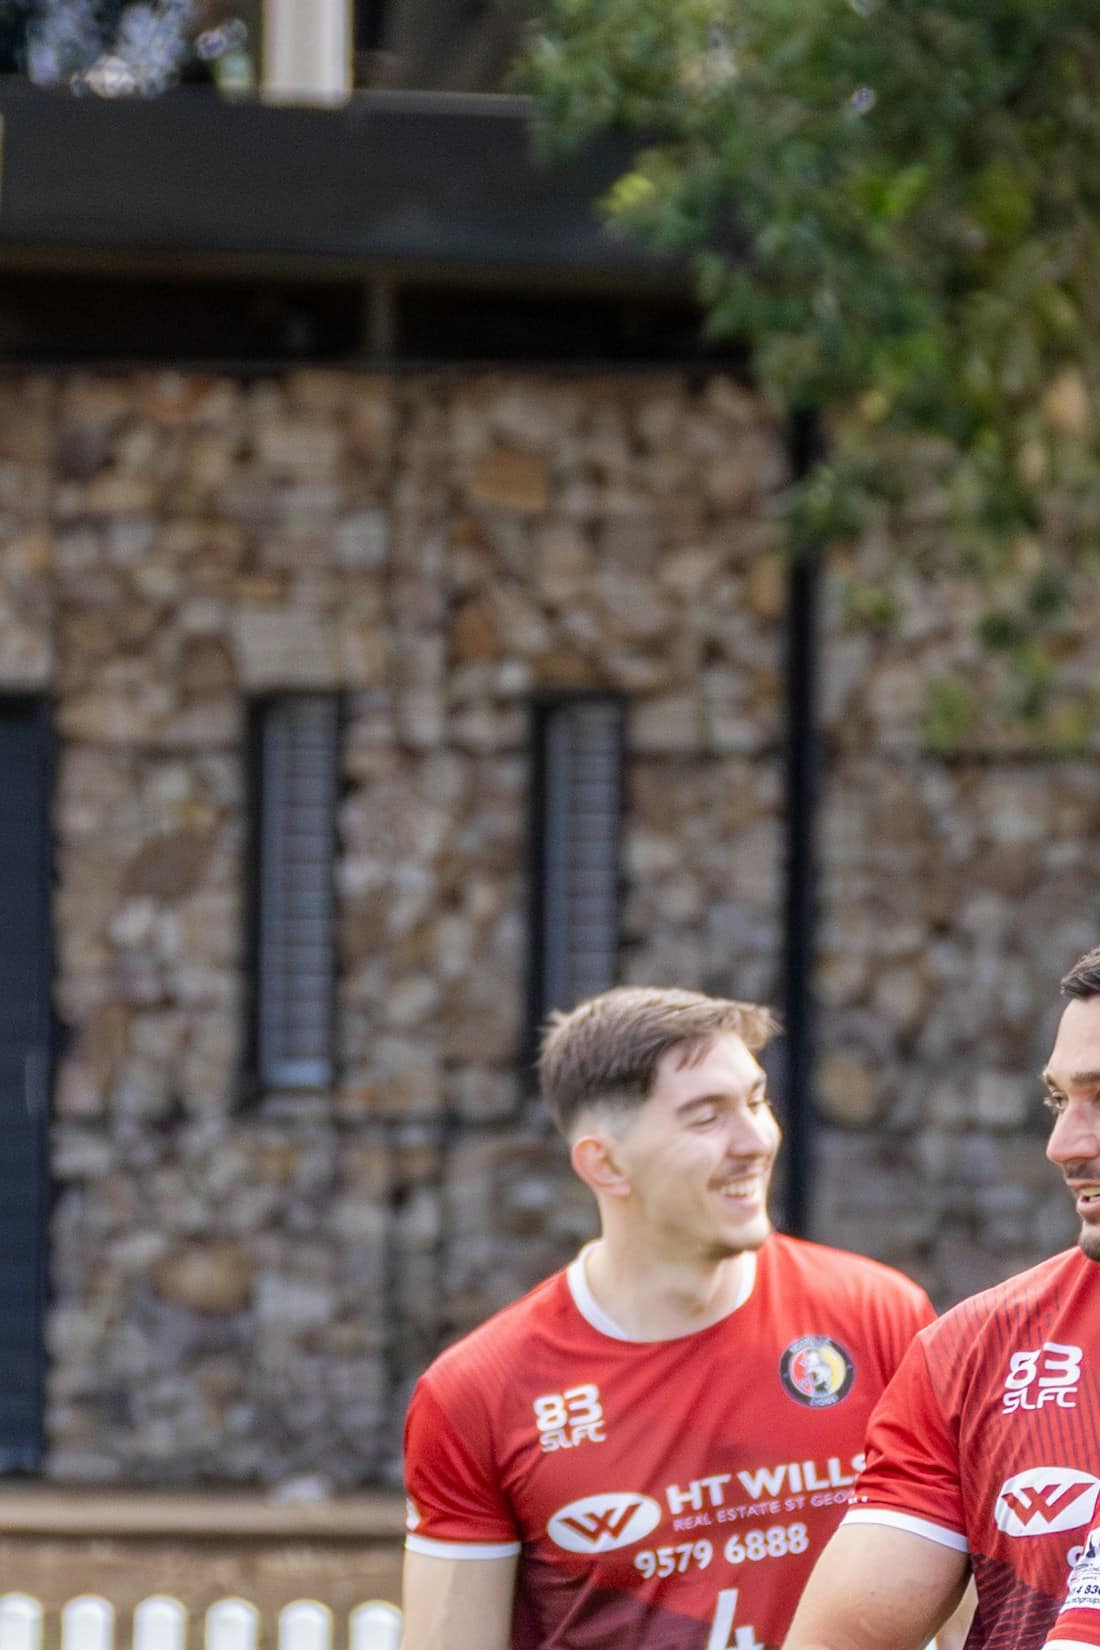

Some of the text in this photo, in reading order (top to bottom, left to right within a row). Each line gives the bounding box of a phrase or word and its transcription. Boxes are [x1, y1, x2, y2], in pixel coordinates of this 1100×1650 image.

[1004, 1341, 1083, 1389] 83
[532, 1384, 602, 1432] 83
[1001, 1387, 1078, 1415] SLFC
[539, 1421, 606, 1453] SLFC
[665, 1474, 731, 1515] HT
[673, 1512, 712, 1531] REAL
[716, 1500, 782, 1524] ESTATE
[783, 1494, 805, 1512] ST
[633, 1521, 811, 1580] 9579 6888
